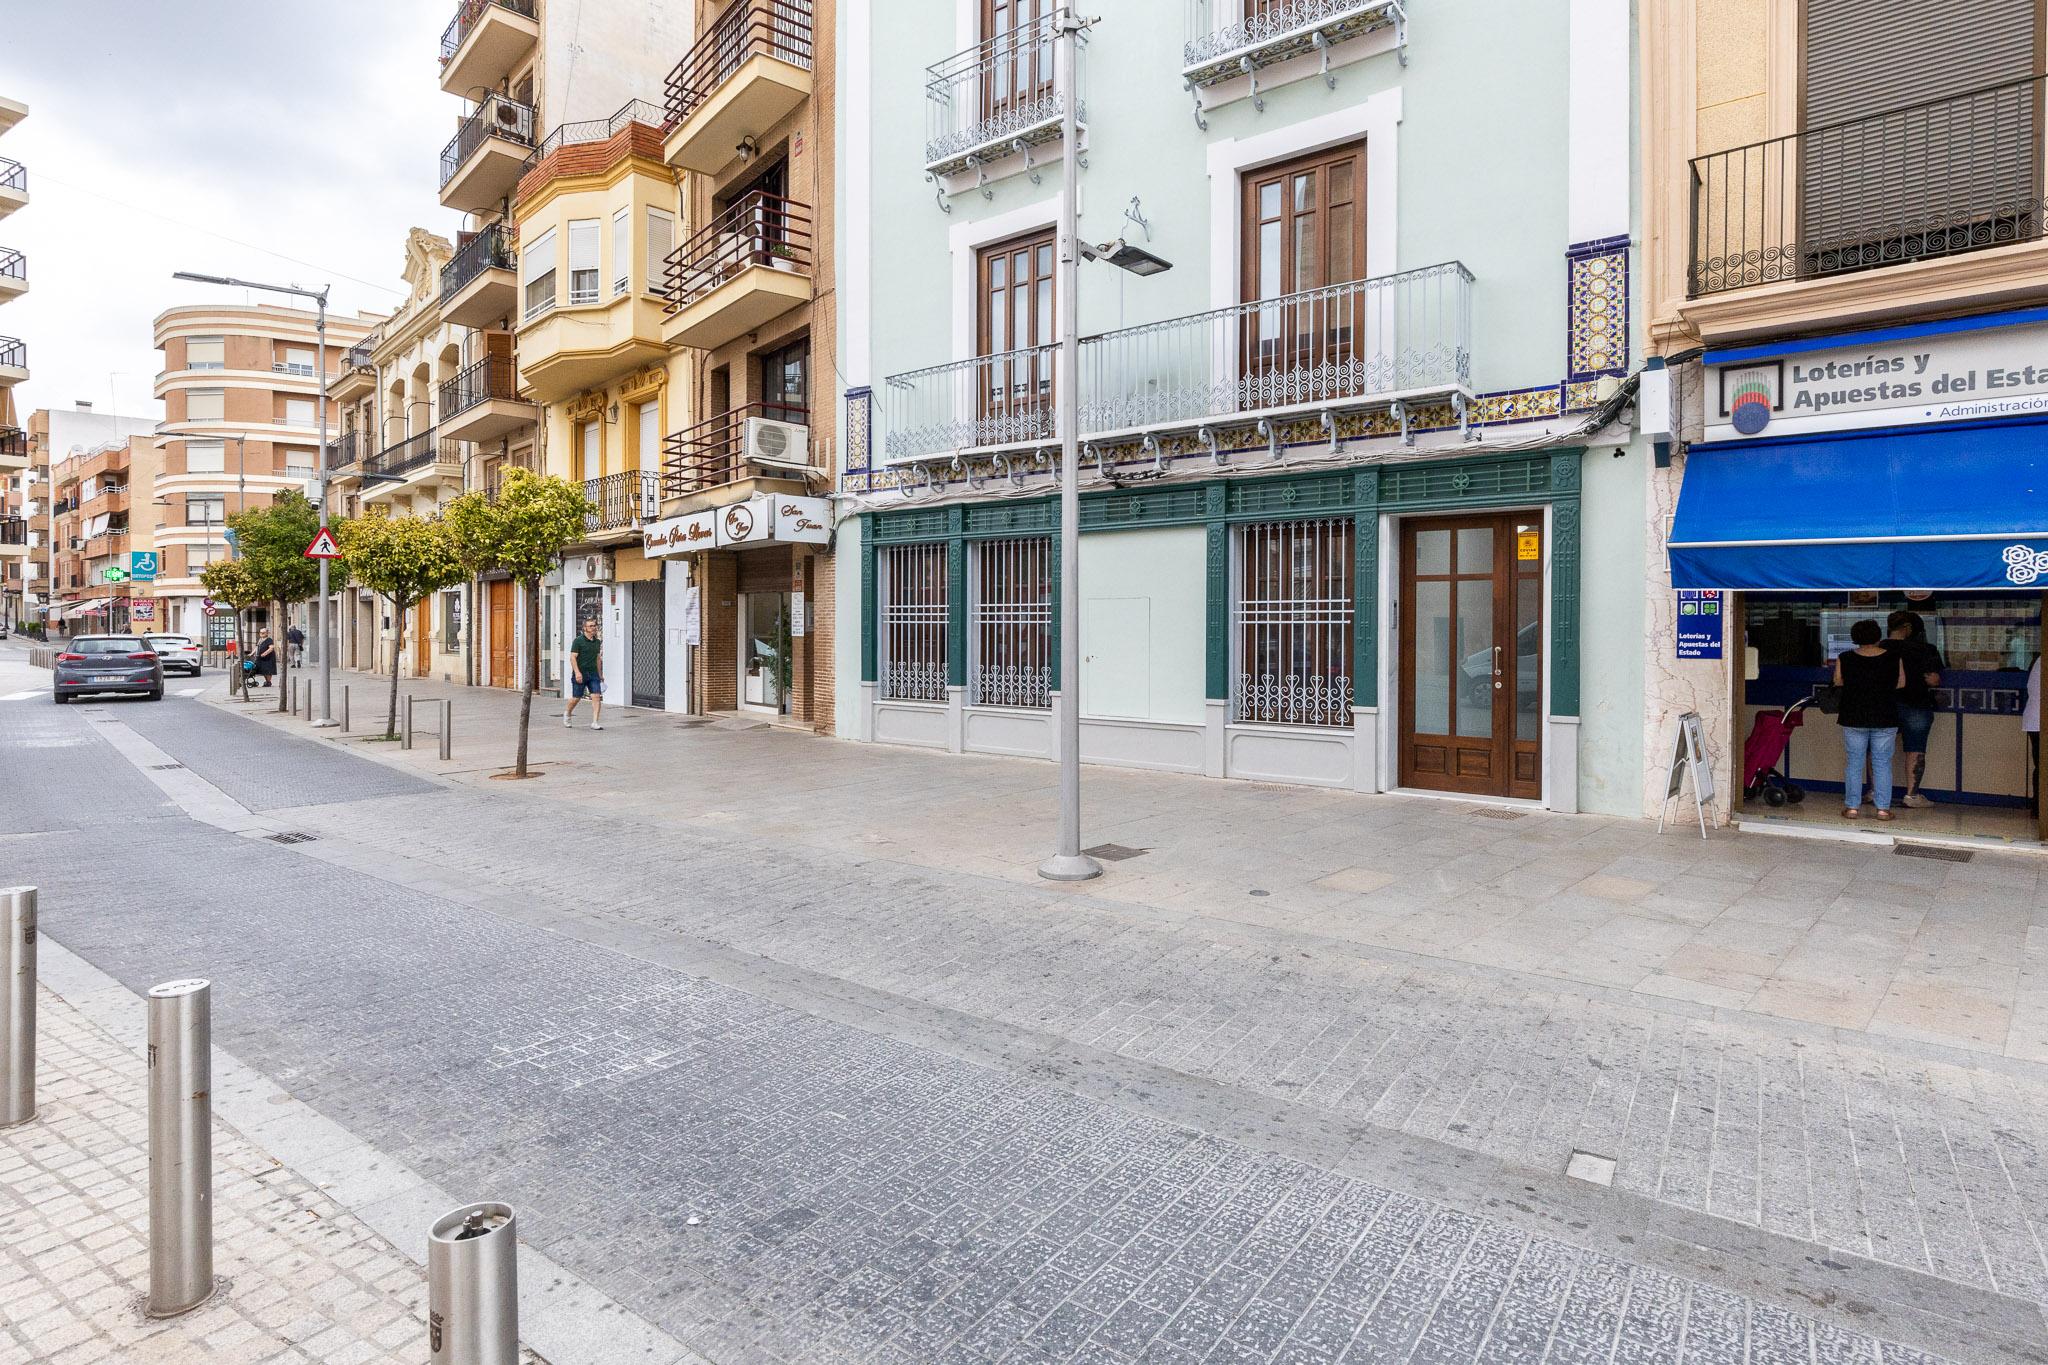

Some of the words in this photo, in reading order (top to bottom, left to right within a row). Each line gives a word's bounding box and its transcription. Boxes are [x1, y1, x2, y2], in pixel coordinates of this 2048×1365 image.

[1793, 355, 1905, 383] Loterías
[1914, 353, 1930, 375] y
[1793, 381, 1922, 411] Apuestas
[1931, 370, 1976, 394] del
